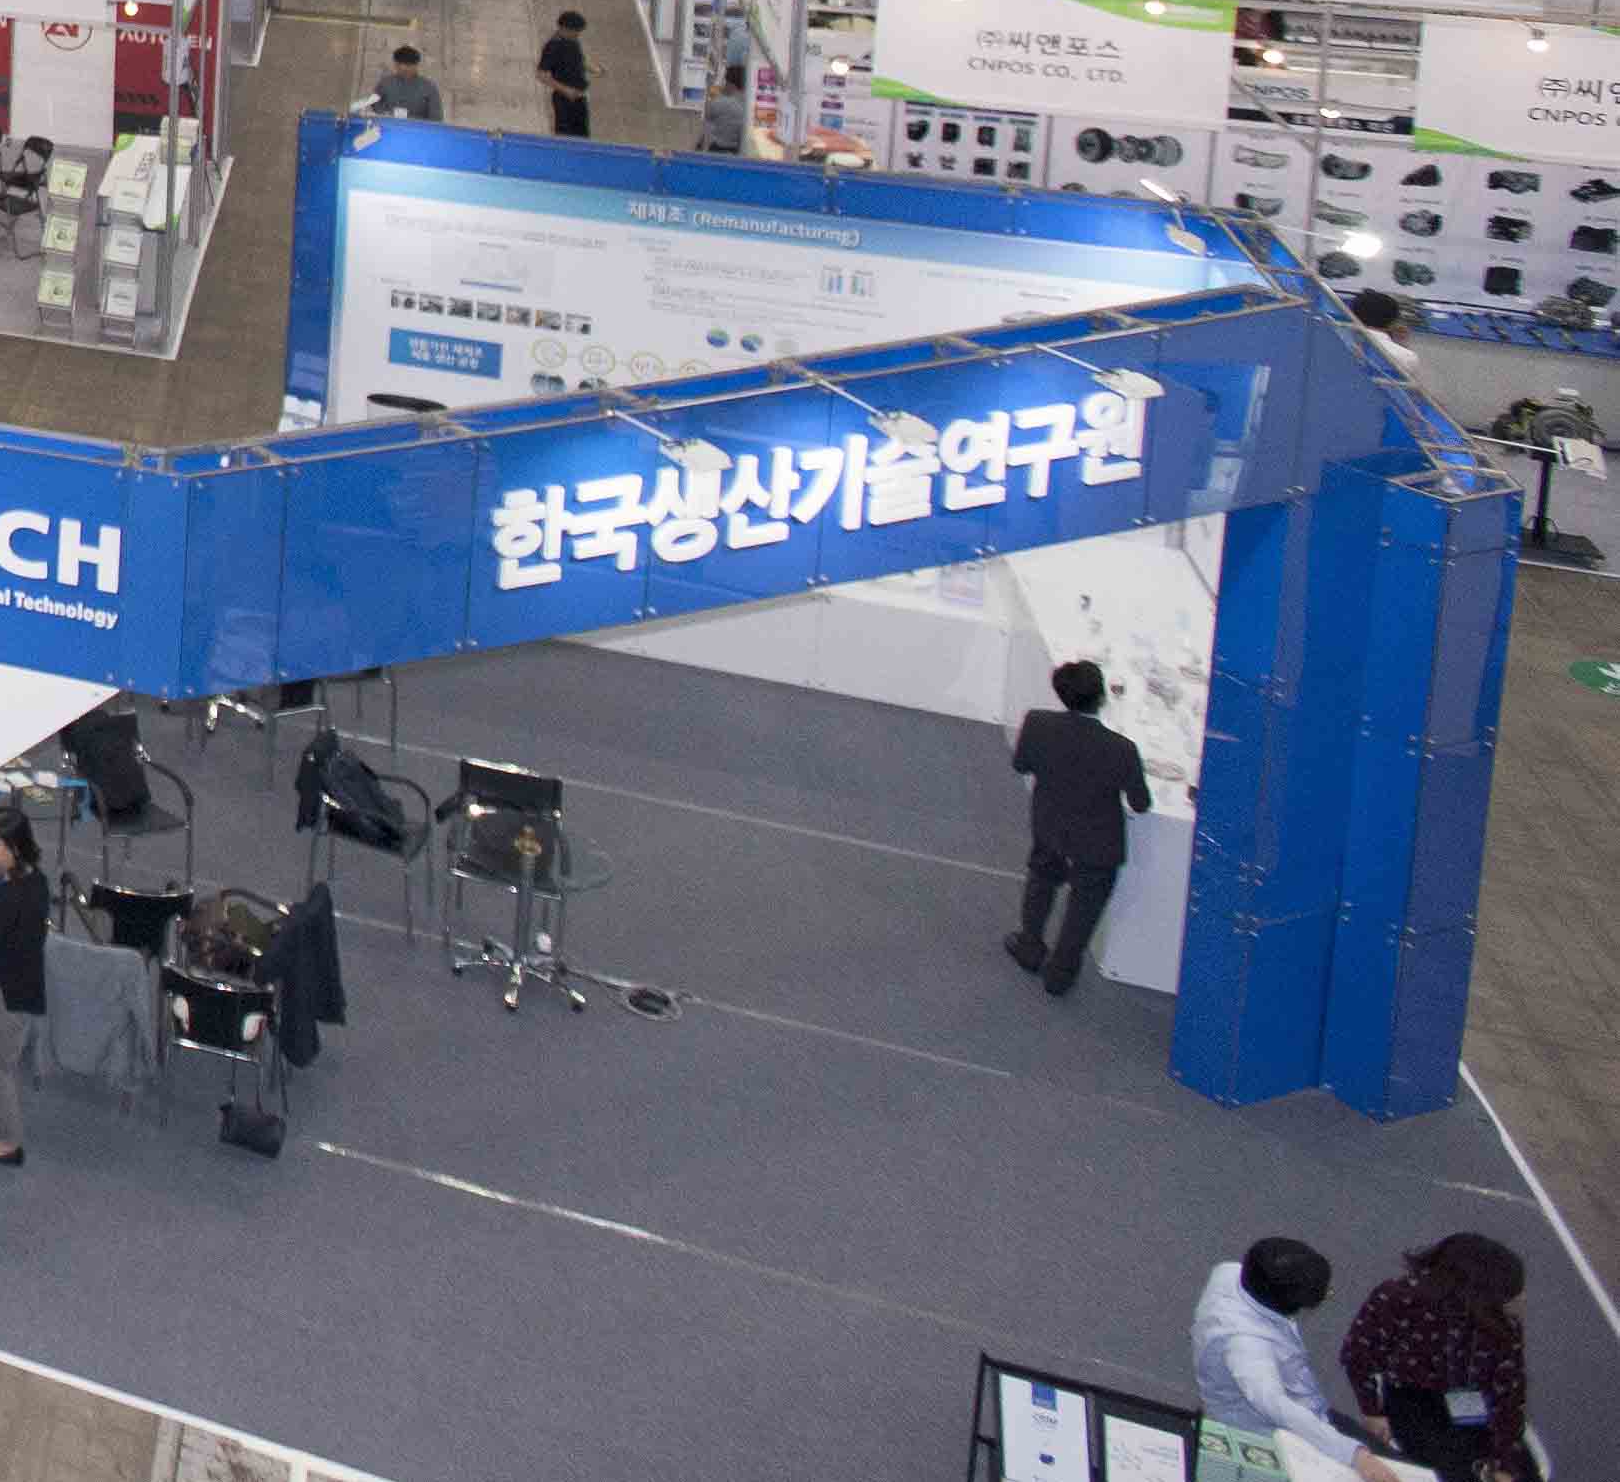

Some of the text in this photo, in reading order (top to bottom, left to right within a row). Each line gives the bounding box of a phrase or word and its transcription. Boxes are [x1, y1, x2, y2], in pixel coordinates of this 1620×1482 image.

[119, 28, 213, 51] AUTOEN
[967, 57, 1035, 78] CNPOS
[1527, 108, 1608, 127] CNPOS
[629, 200, 863, 248] 재제조 (Remanufacturing)
[490, 391, 1144, 593] 한국생산기술연구원
[14, 589, 119, 630] Technology
